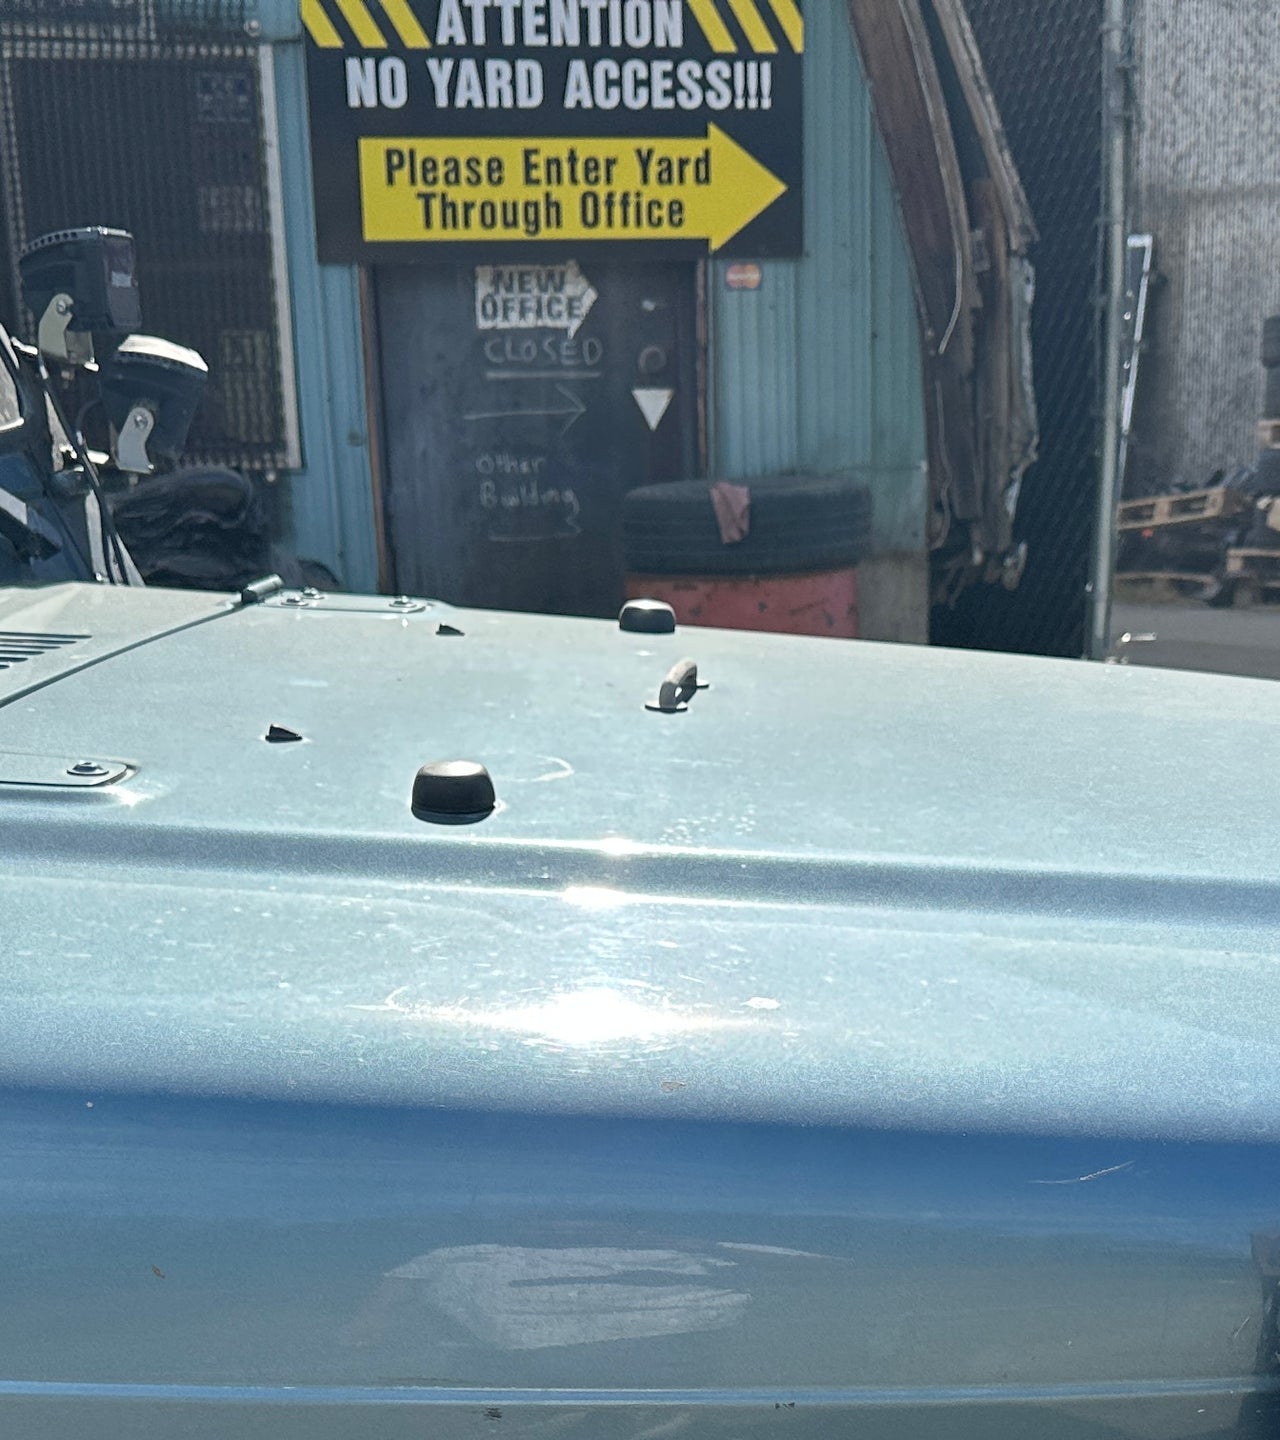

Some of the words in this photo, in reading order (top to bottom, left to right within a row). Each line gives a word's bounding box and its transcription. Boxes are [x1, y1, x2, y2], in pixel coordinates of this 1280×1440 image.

[435, 0, 683, 48] ATTENTION
[345, 56, 408, 109] NO
[426, 58, 544, 110] YARD
[563, 60, 772, 110] ACCESS!!!
[385, 148, 504, 187] Please
[523, 148, 617, 186] Enter
[635, 148, 712, 186] Yard
[416, 192, 562, 236] Through
[581, 193, 685, 229] Office
[490, 270, 566, 293] NEW
[481, 294, 582, 321] OFFICE
[484, 336, 603, 366] CLOSED
